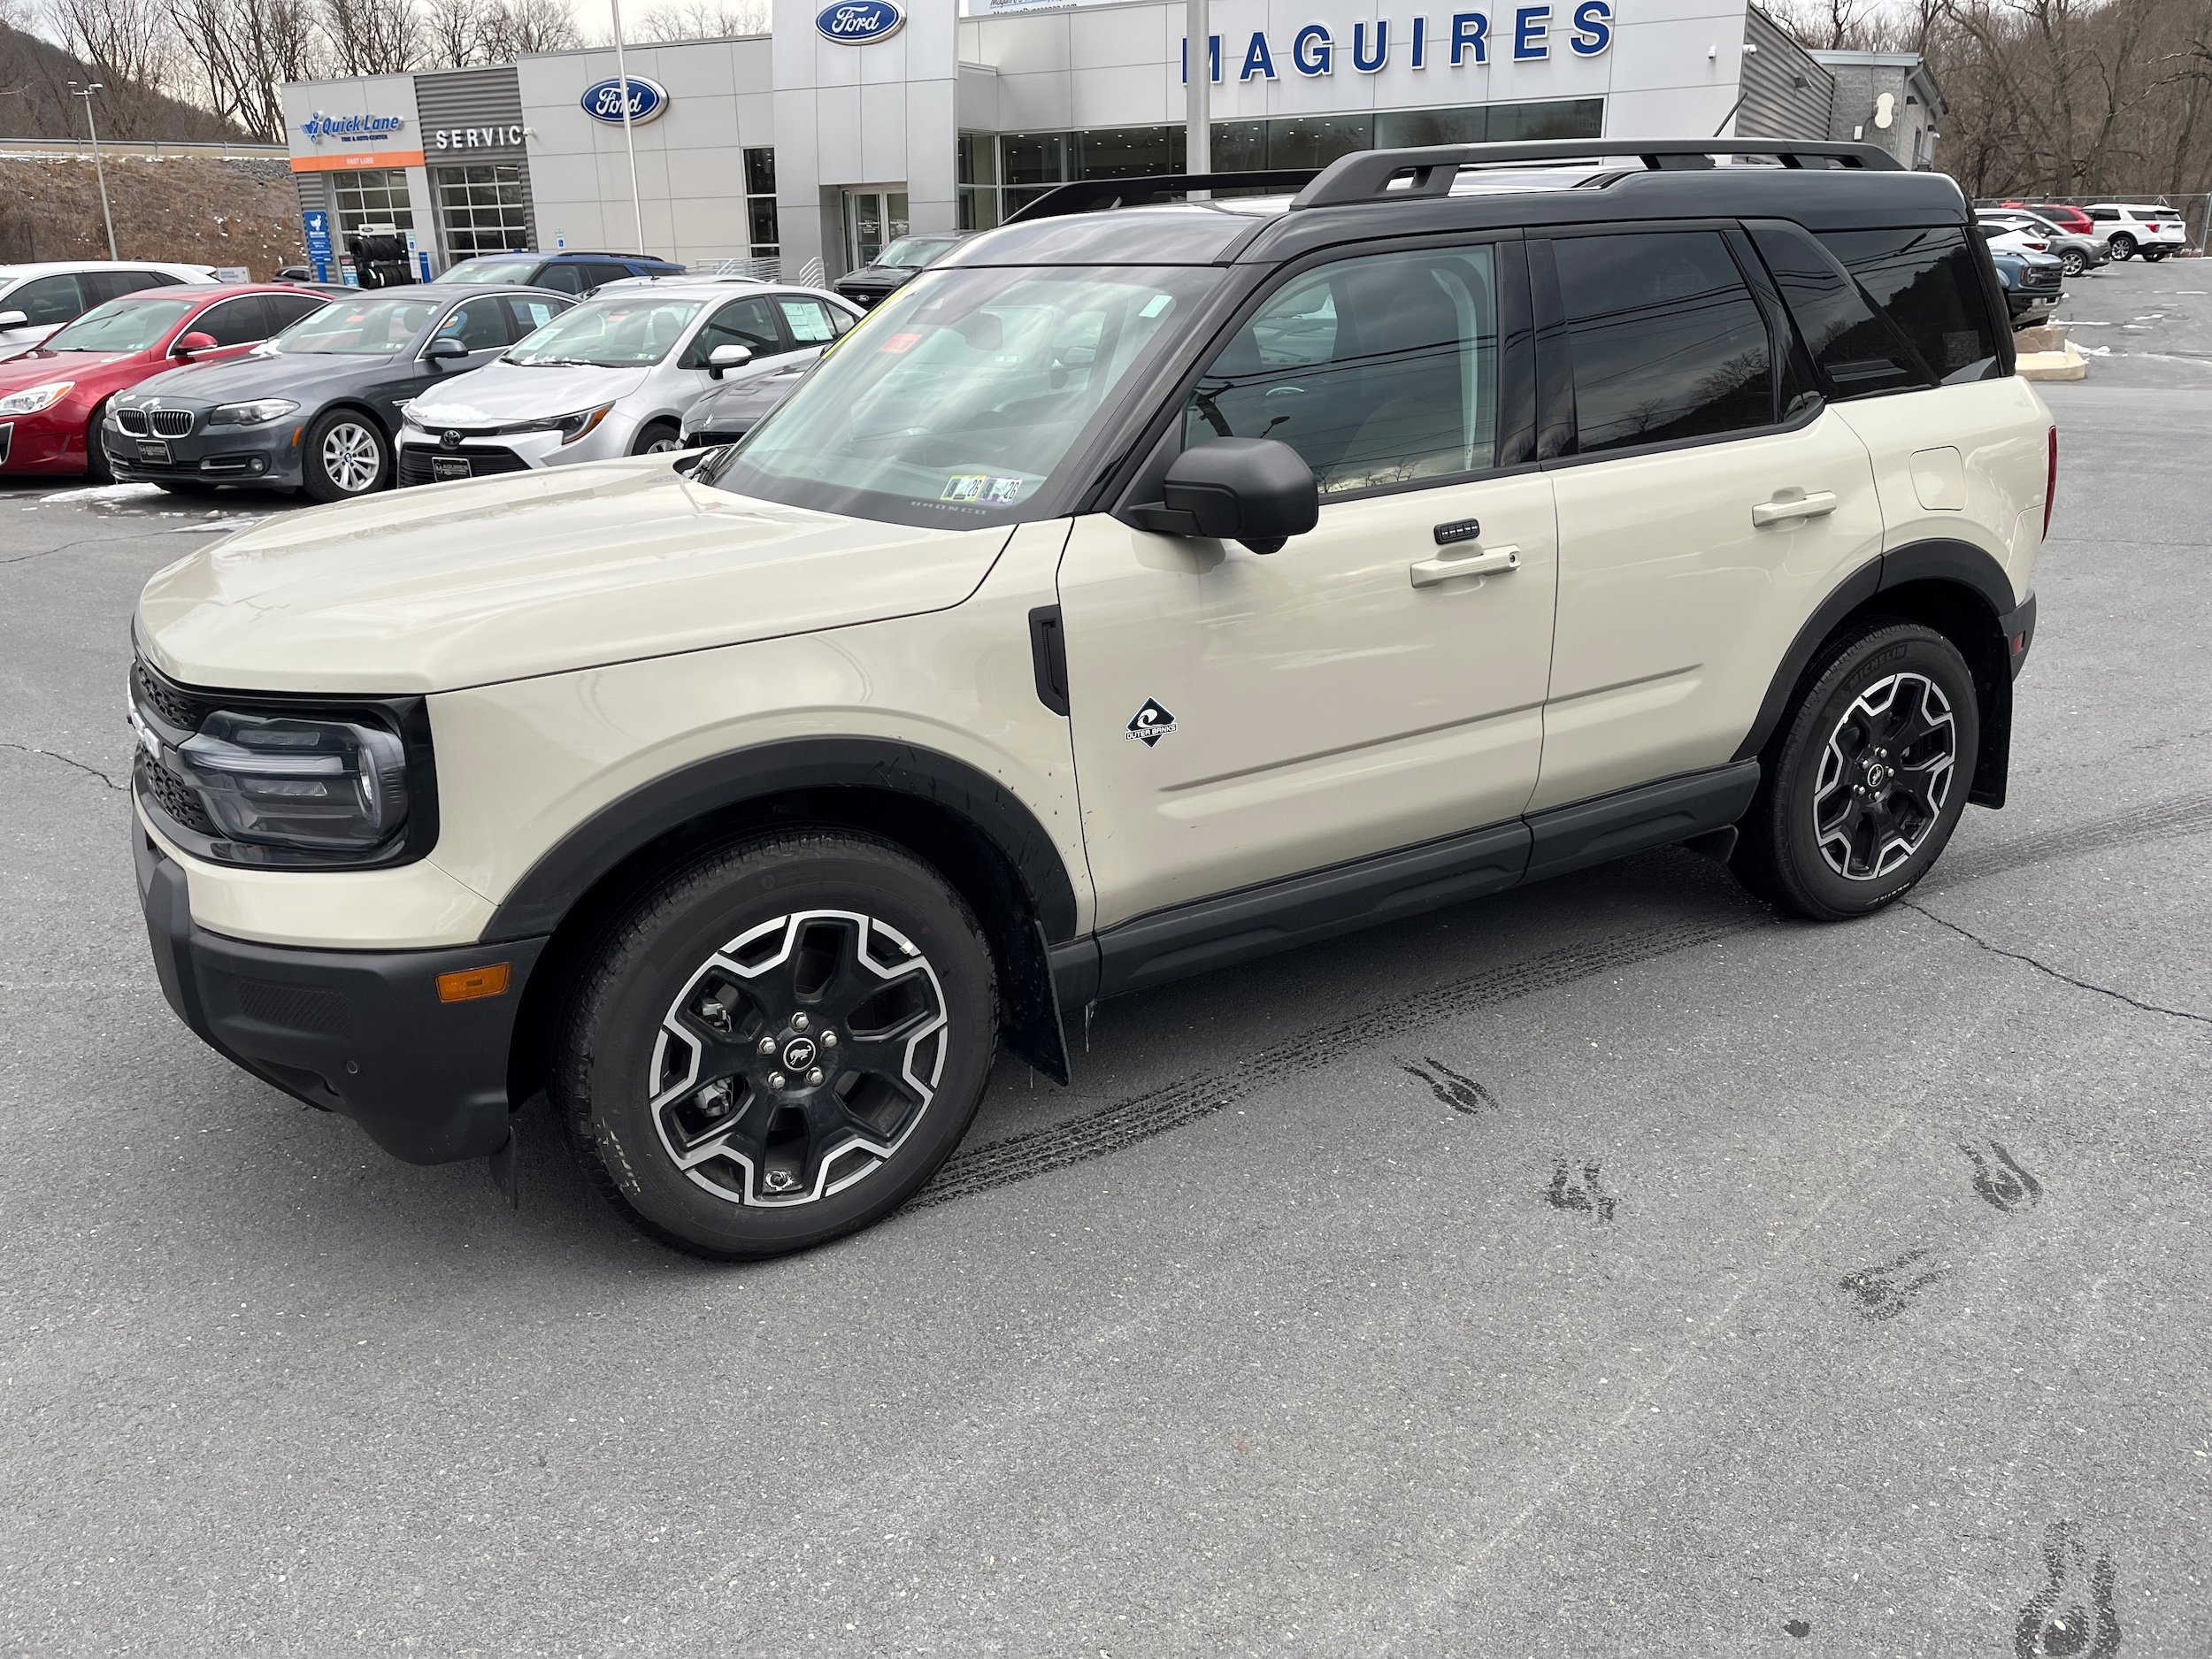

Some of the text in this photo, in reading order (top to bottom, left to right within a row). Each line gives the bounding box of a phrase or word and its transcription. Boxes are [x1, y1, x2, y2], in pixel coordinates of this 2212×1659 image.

[832, 5, 881, 33] Ford
[595, 87, 641, 114] Fod
[322, 115, 399, 135] Quick Lane
[436, 125, 522, 149] SERVIC
[967, 480, 982, 496] 26
[1004, 481, 1019, 499] 26
[910, 501, 987, 515] BRONCO
[1849, 646, 1905, 689] MICHELIN
[1126, 725, 1176, 740] OUTER BANKS
